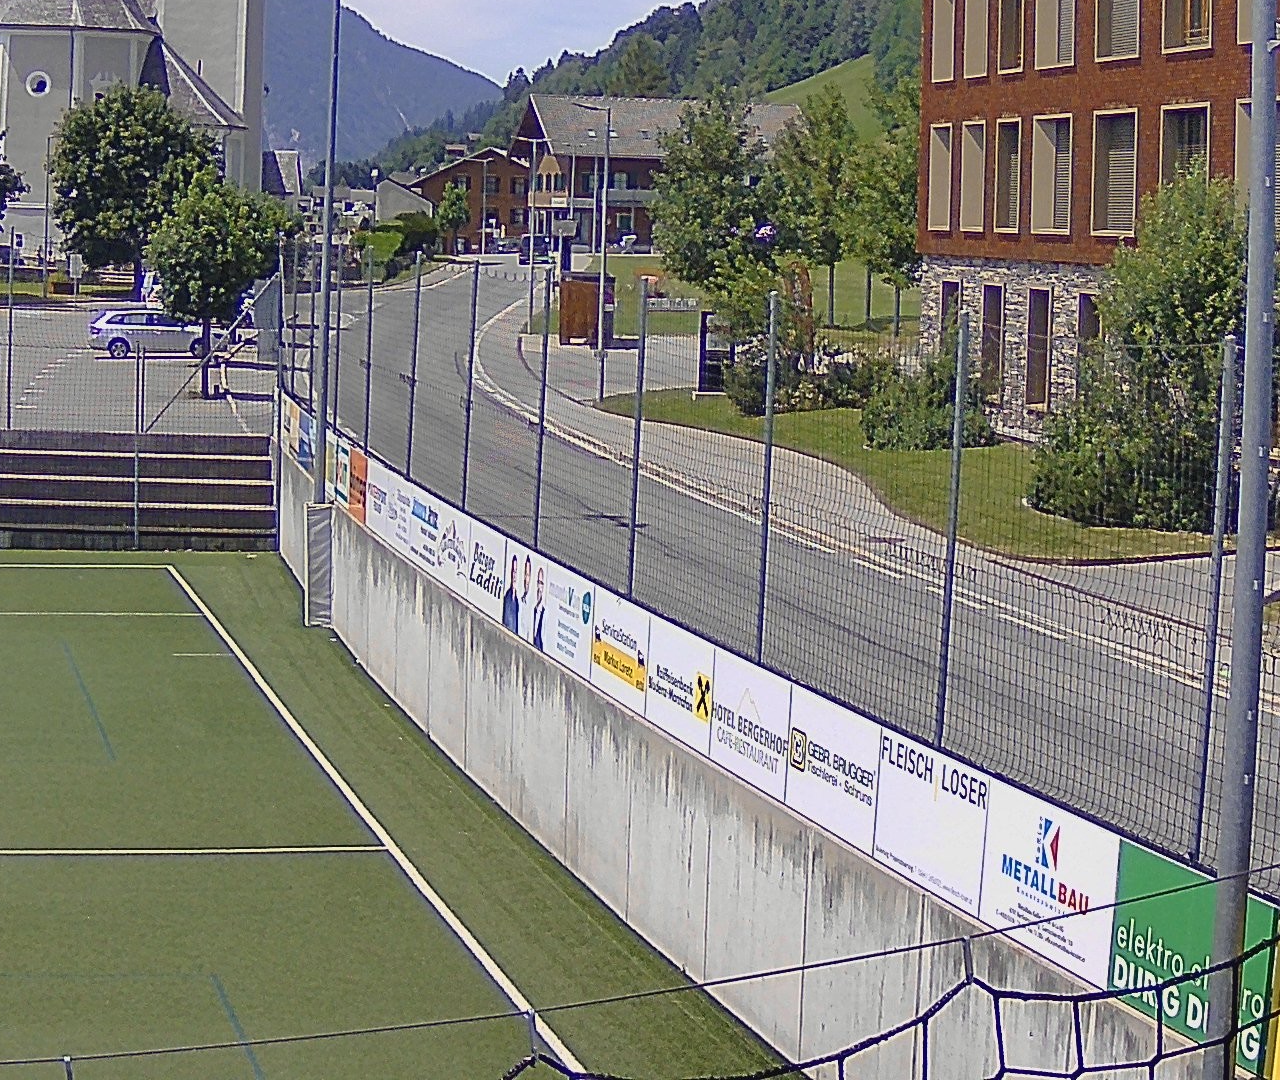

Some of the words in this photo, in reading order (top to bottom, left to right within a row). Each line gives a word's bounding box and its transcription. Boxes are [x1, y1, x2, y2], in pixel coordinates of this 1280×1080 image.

[656, 664, 693, 697] Raiffeisenbank
[711, 700, 735, 730] HOTEL
[738, 715, 789, 757] BERGERHOF
[807, 759, 838, 787] Tischlerei
[844, 780, 873, 807] Schruns
[808, 740, 831, 767] GEBR.
[833, 753, 874, 791] BRUGGER
[881, 735, 934, 784] FLEISCH
[942, 763, 988, 810] LOSER
[1001, 853, 1090, 916] METALLBAU
[1117, 918, 1184, 977] elektro
